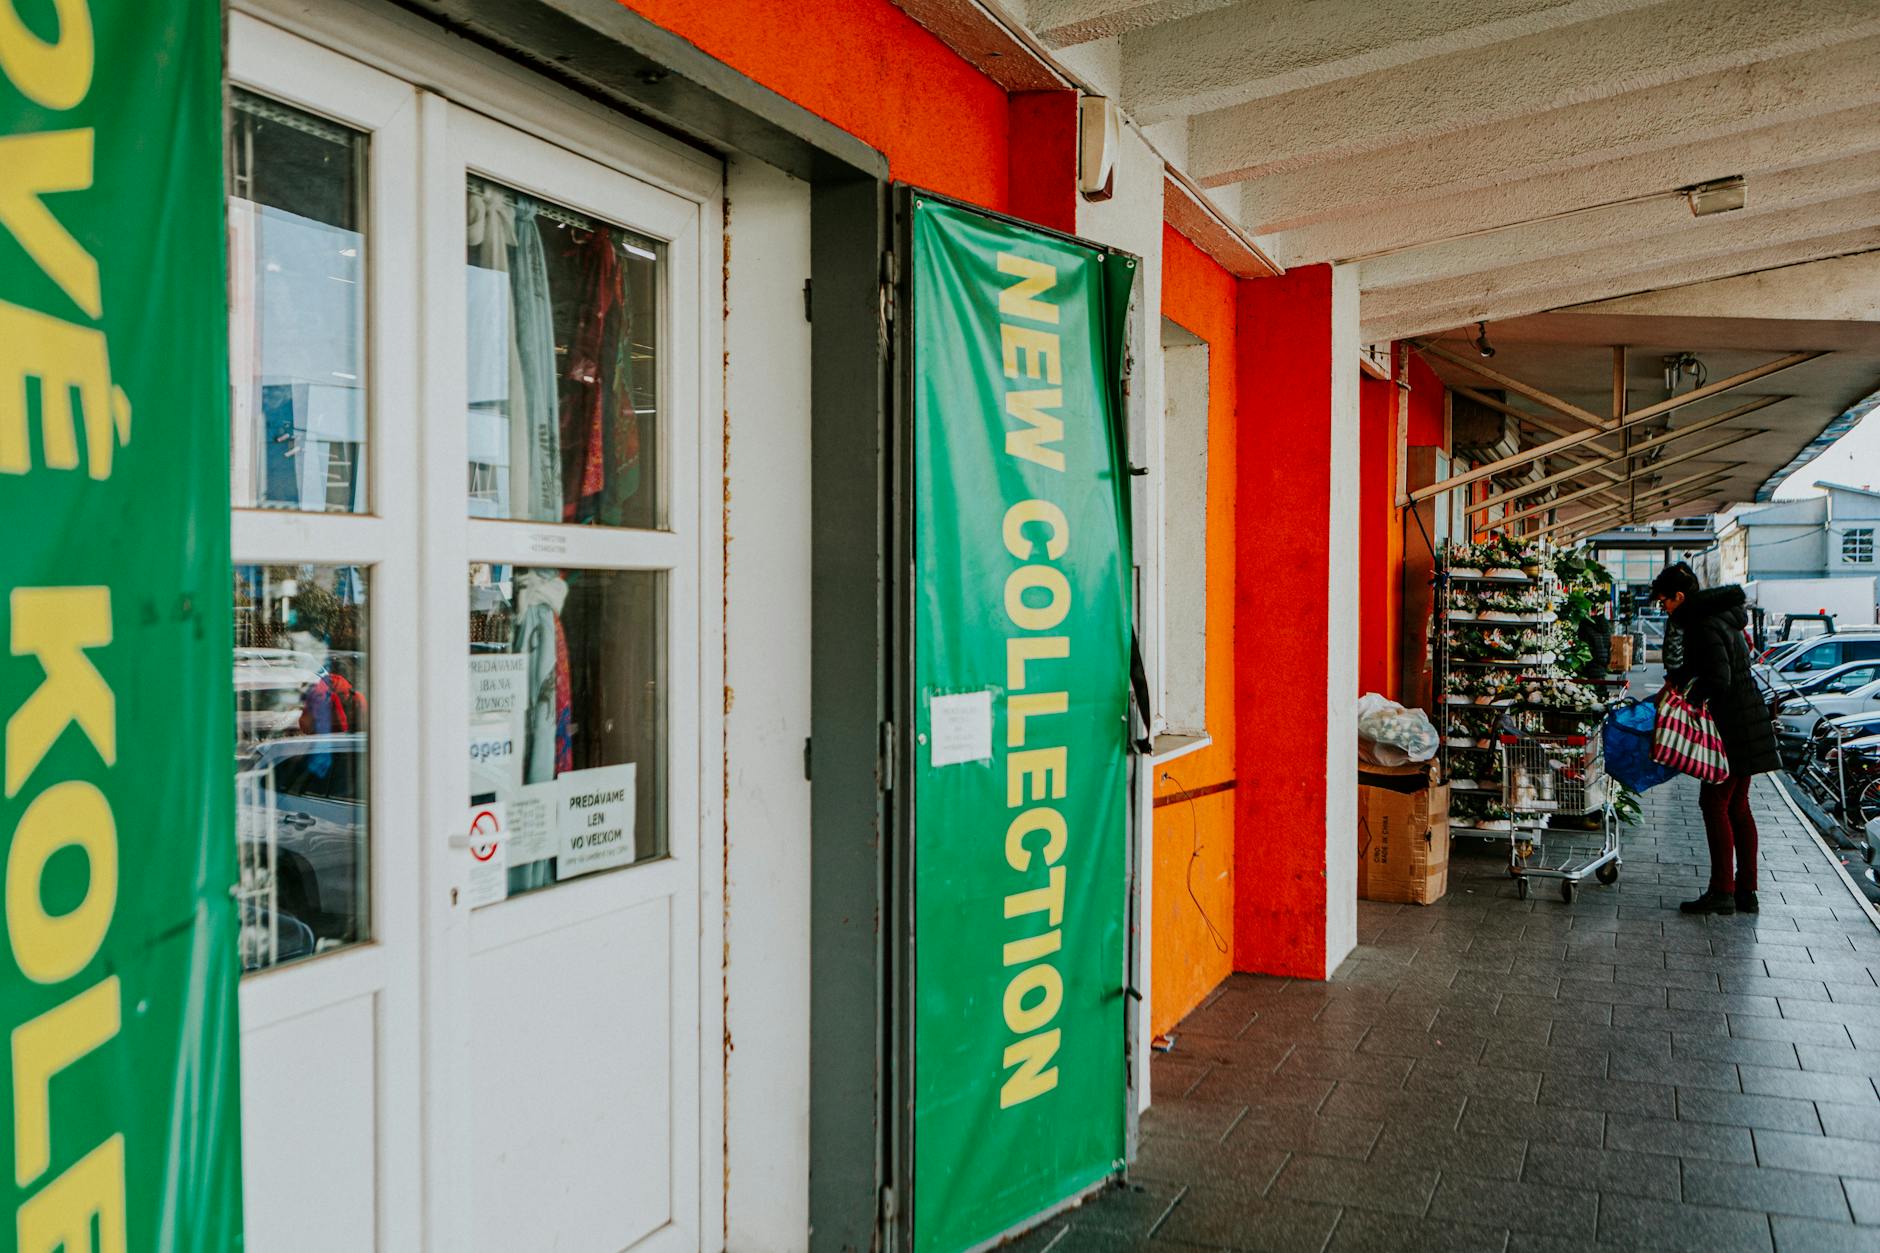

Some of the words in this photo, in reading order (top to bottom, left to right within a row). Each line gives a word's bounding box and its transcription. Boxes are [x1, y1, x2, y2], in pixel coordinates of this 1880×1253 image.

[997, 251, 1066, 472] NEW
[470, 740, 513, 763] open
[570, 788, 625, 809] PREDÁVAME
[1001, 499, 1072, 1109] COLLECTION
[587, 812, 605, 828] LEN
[571, 836, 584, 850] VO
